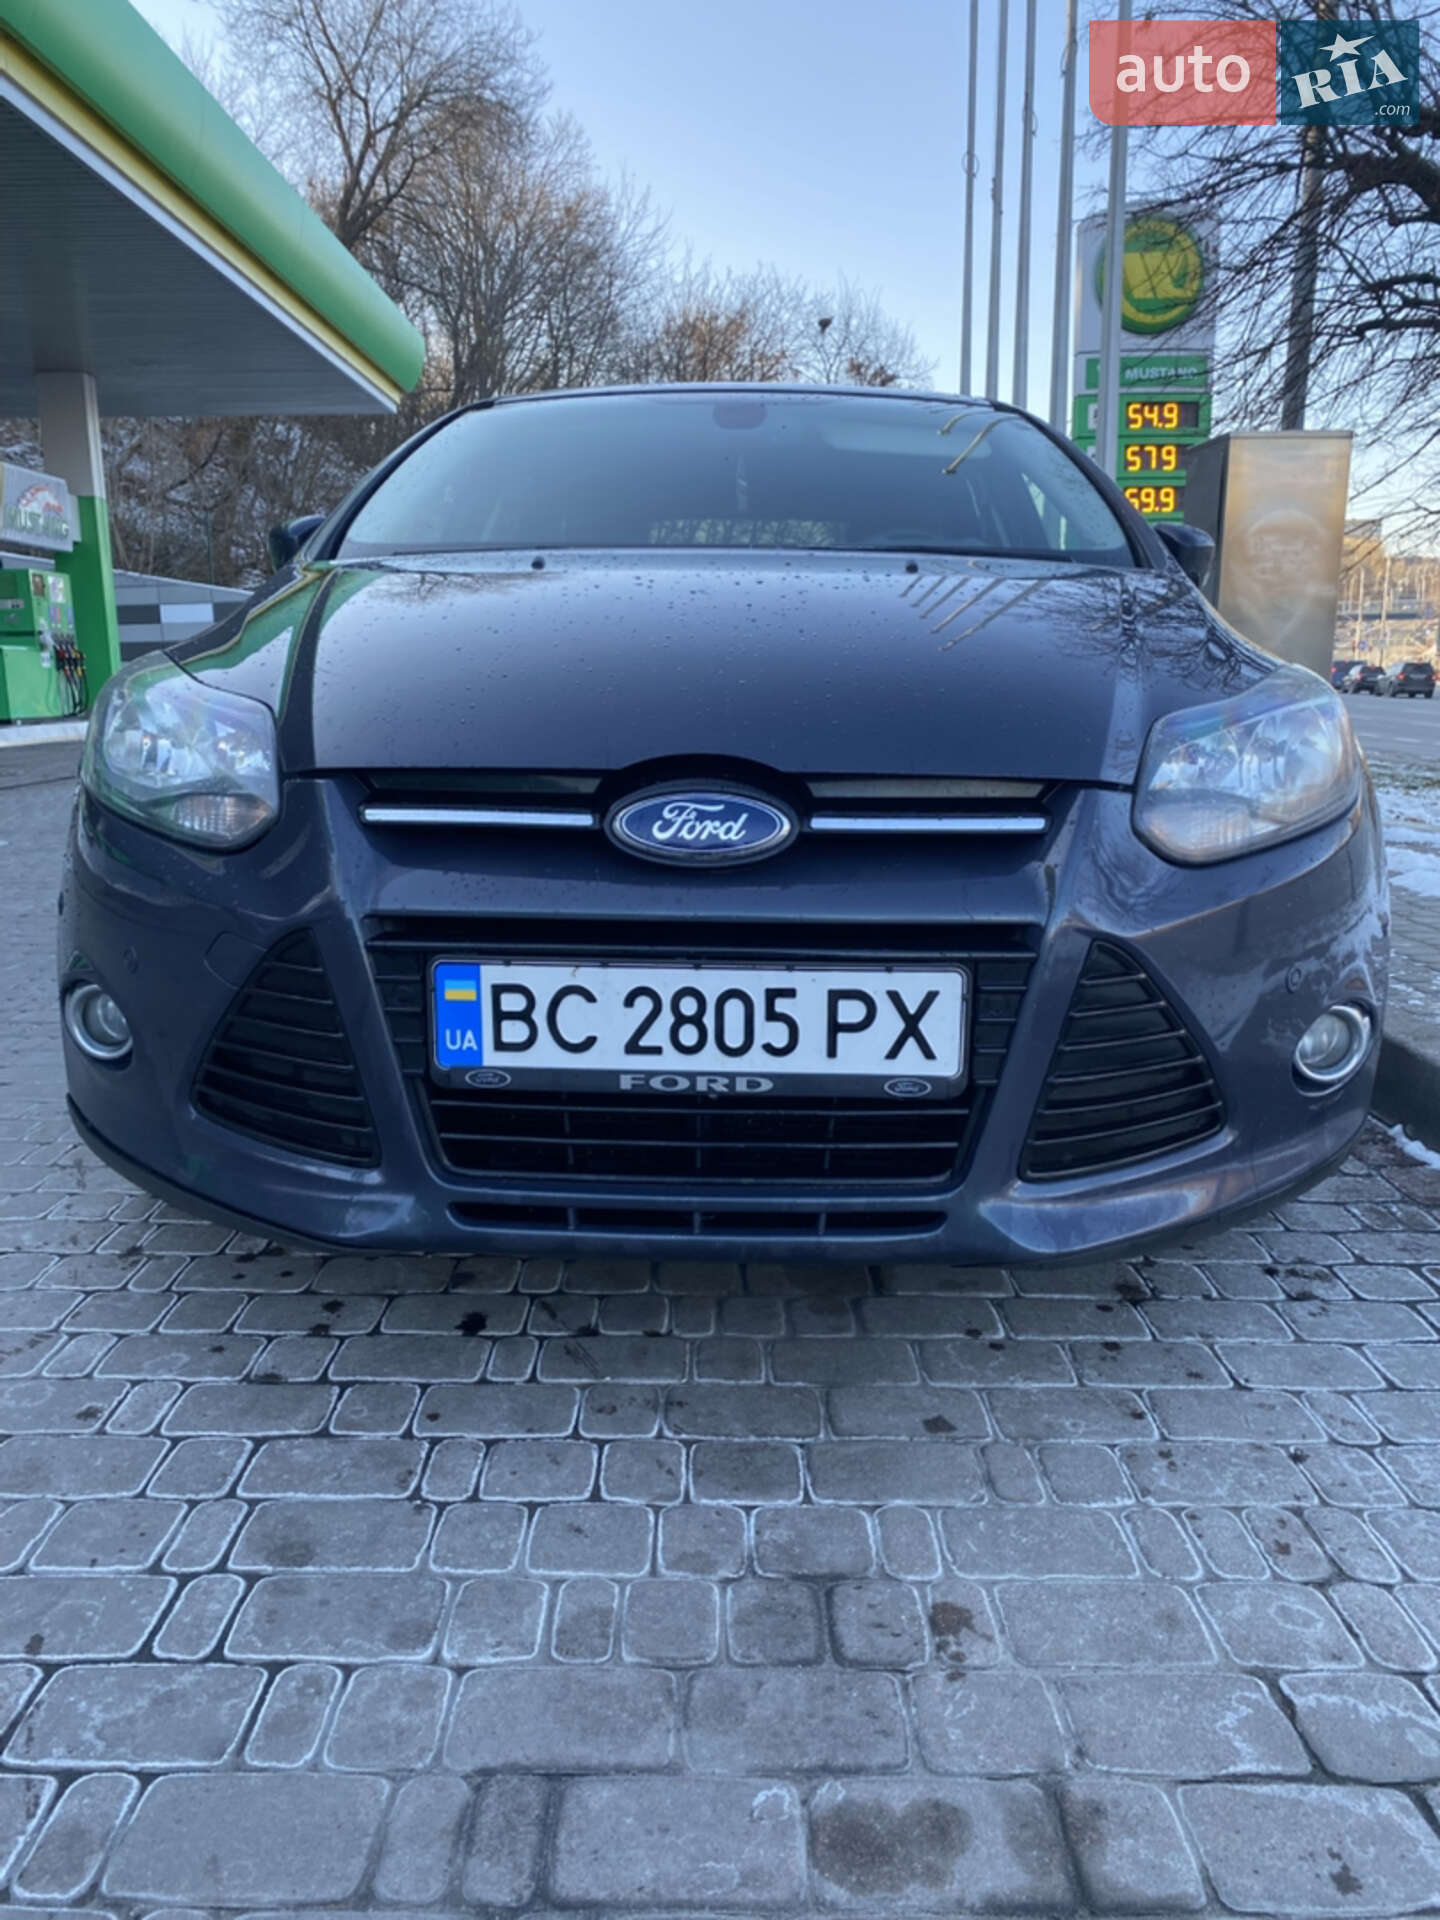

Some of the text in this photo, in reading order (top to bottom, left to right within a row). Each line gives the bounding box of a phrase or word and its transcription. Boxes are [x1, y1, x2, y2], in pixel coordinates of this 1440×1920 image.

[1127, 402, 1180, 430] 54.9
[652, 801, 749, 840] Ford
[490, 983, 940, 1060] BC 2805 PX
[445, 1028, 478, 1051] UA
[619, 1073, 774, 1094] FORD
